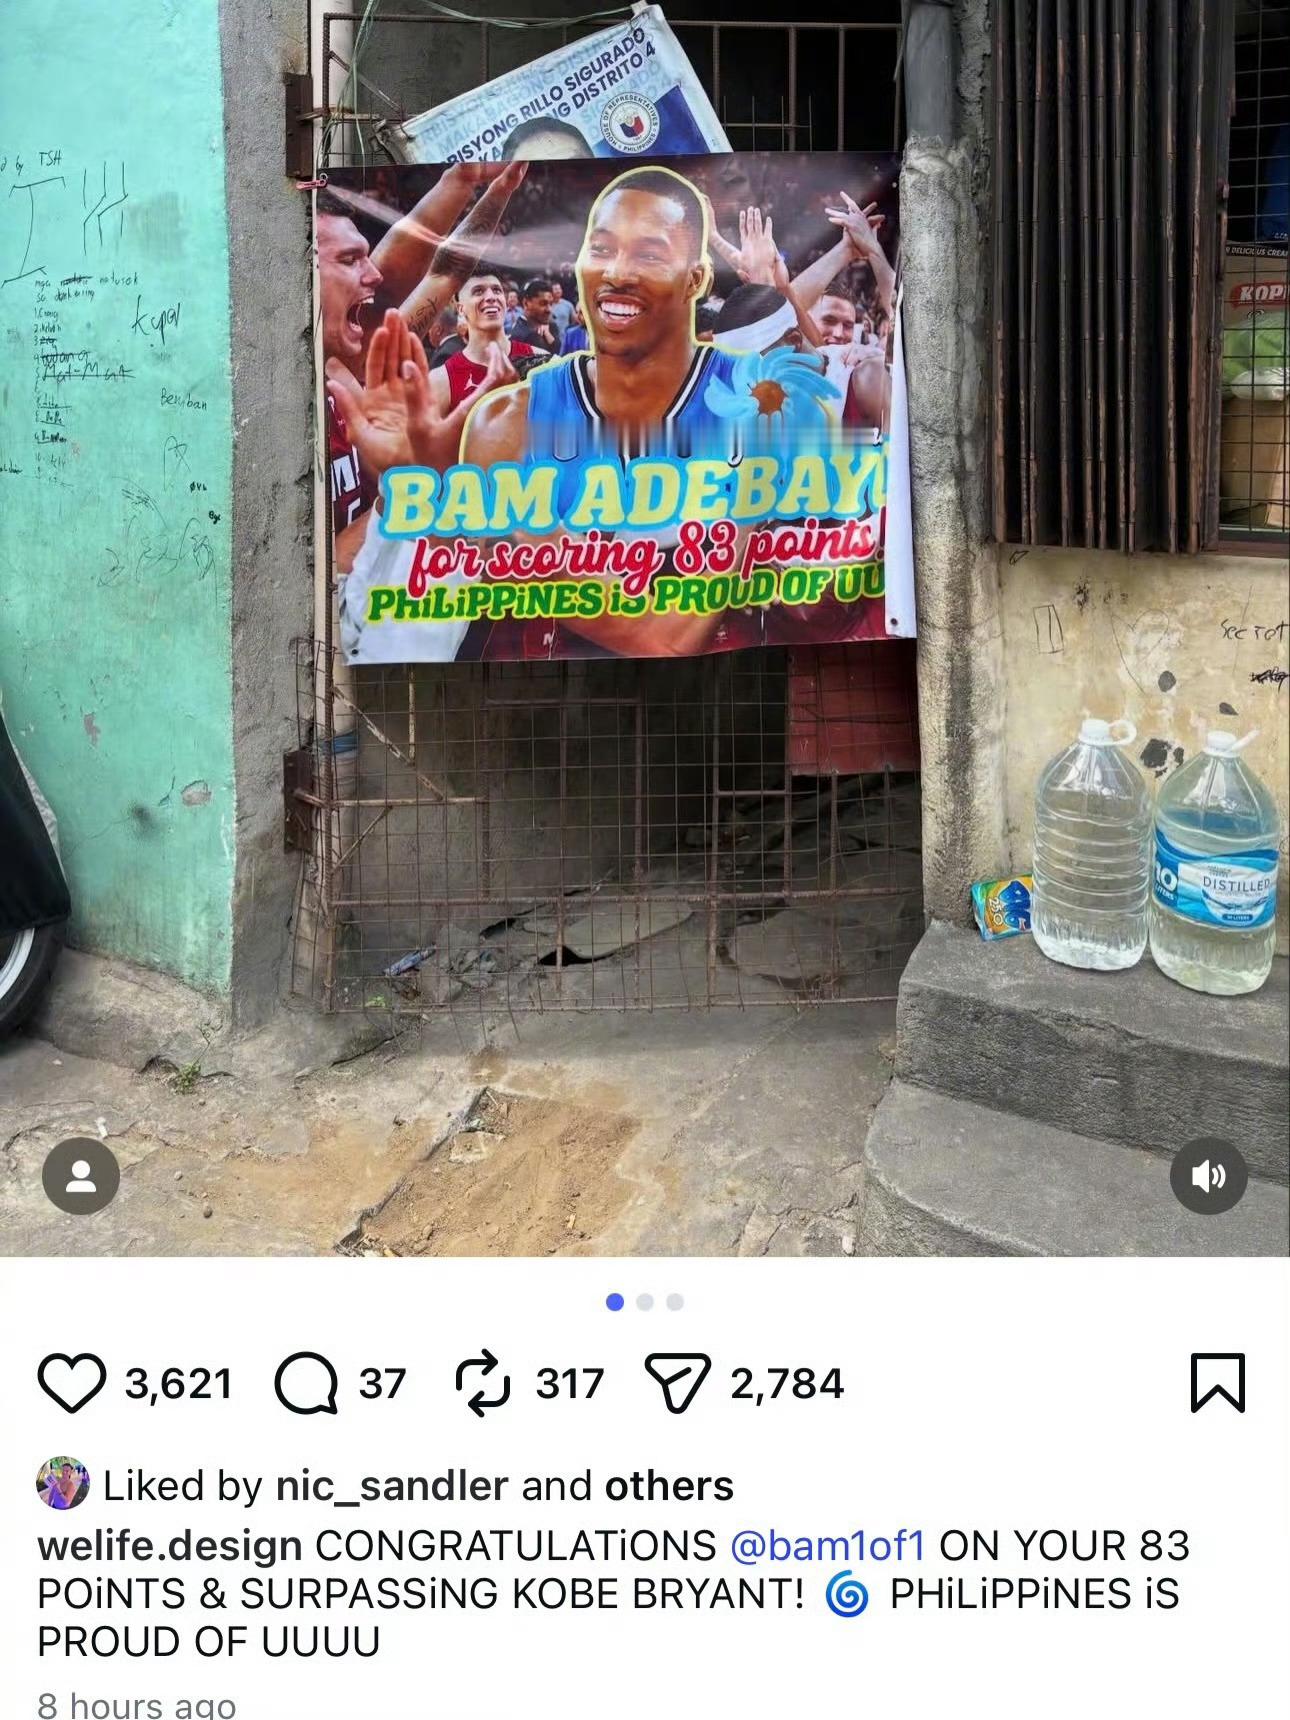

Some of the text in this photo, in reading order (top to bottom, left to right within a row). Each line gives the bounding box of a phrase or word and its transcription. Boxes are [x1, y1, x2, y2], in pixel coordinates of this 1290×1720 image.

[519, 85, 564, 119] RILLO
[564, 27, 645, 92] SIGURADO
[571, 52, 643, 109] DISTRITO
[645, 41, 656, 58] 4
[602, 94, 659, 147] HOUSE OF REPRESENTATIVES
[39, 149, 62, 166] TSH
[381, 463, 561, 536] BAM
[407, 537, 483, 598] for
[485, 530, 666, 597] scoring
[673, 520, 739, 576] 83
[652, 568, 779, 616] PROUD
[780, 566, 834, 605] OF
[1203, 876, 1270, 893] DISTILLED
[988, 897, 1004, 926] 250
